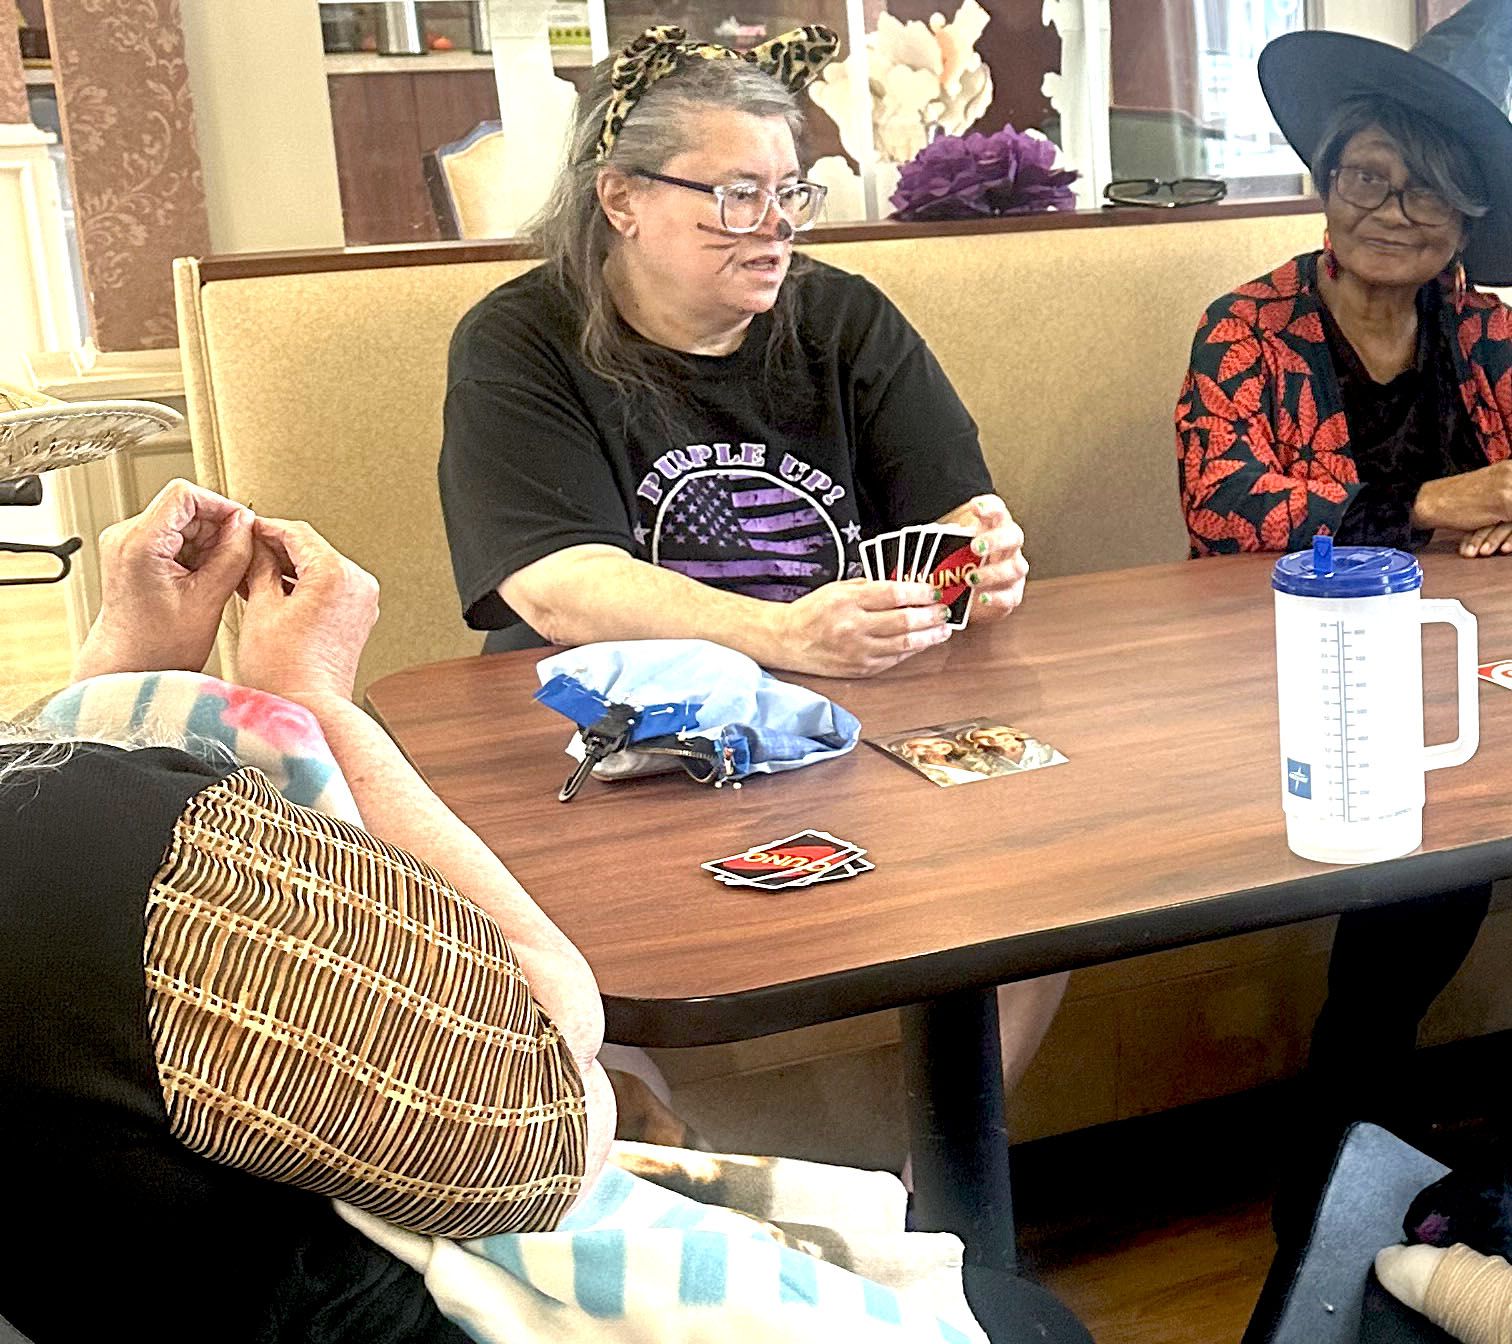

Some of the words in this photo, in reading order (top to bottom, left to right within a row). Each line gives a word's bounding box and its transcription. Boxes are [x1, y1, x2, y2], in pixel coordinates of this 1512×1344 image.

[637, 442, 767, 506] PURPLE
[779, 452, 846, 506] UP!
[744, 852, 809, 868] UNO
